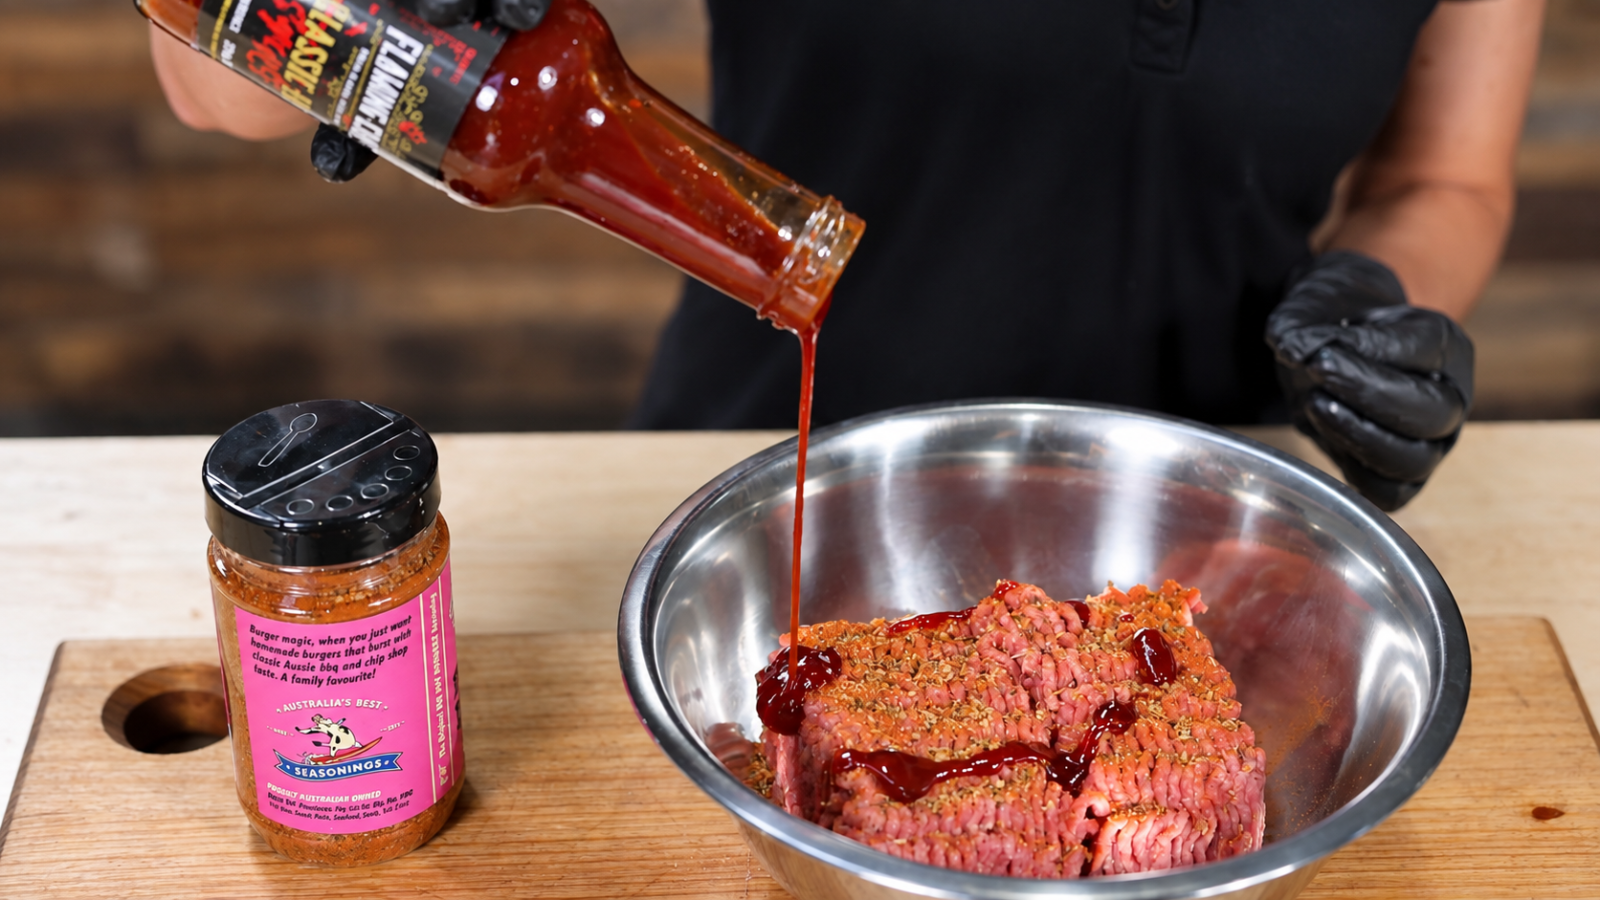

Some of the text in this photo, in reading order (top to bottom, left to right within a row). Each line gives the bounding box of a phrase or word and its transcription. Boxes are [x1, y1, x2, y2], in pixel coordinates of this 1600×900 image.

[249, 615, 412, 647] Burger magic, when you just want
[250, 628, 411, 661] homemade burgers that burst with
[252, 645, 408, 674] classic Aussie bbq and chip shop
[254, 664, 376, 688] taste. A family favourite!
[283, 699, 382, 712] AUSTRALIA'S BEST
[294, 759, 382, 778] SEASONINGS
